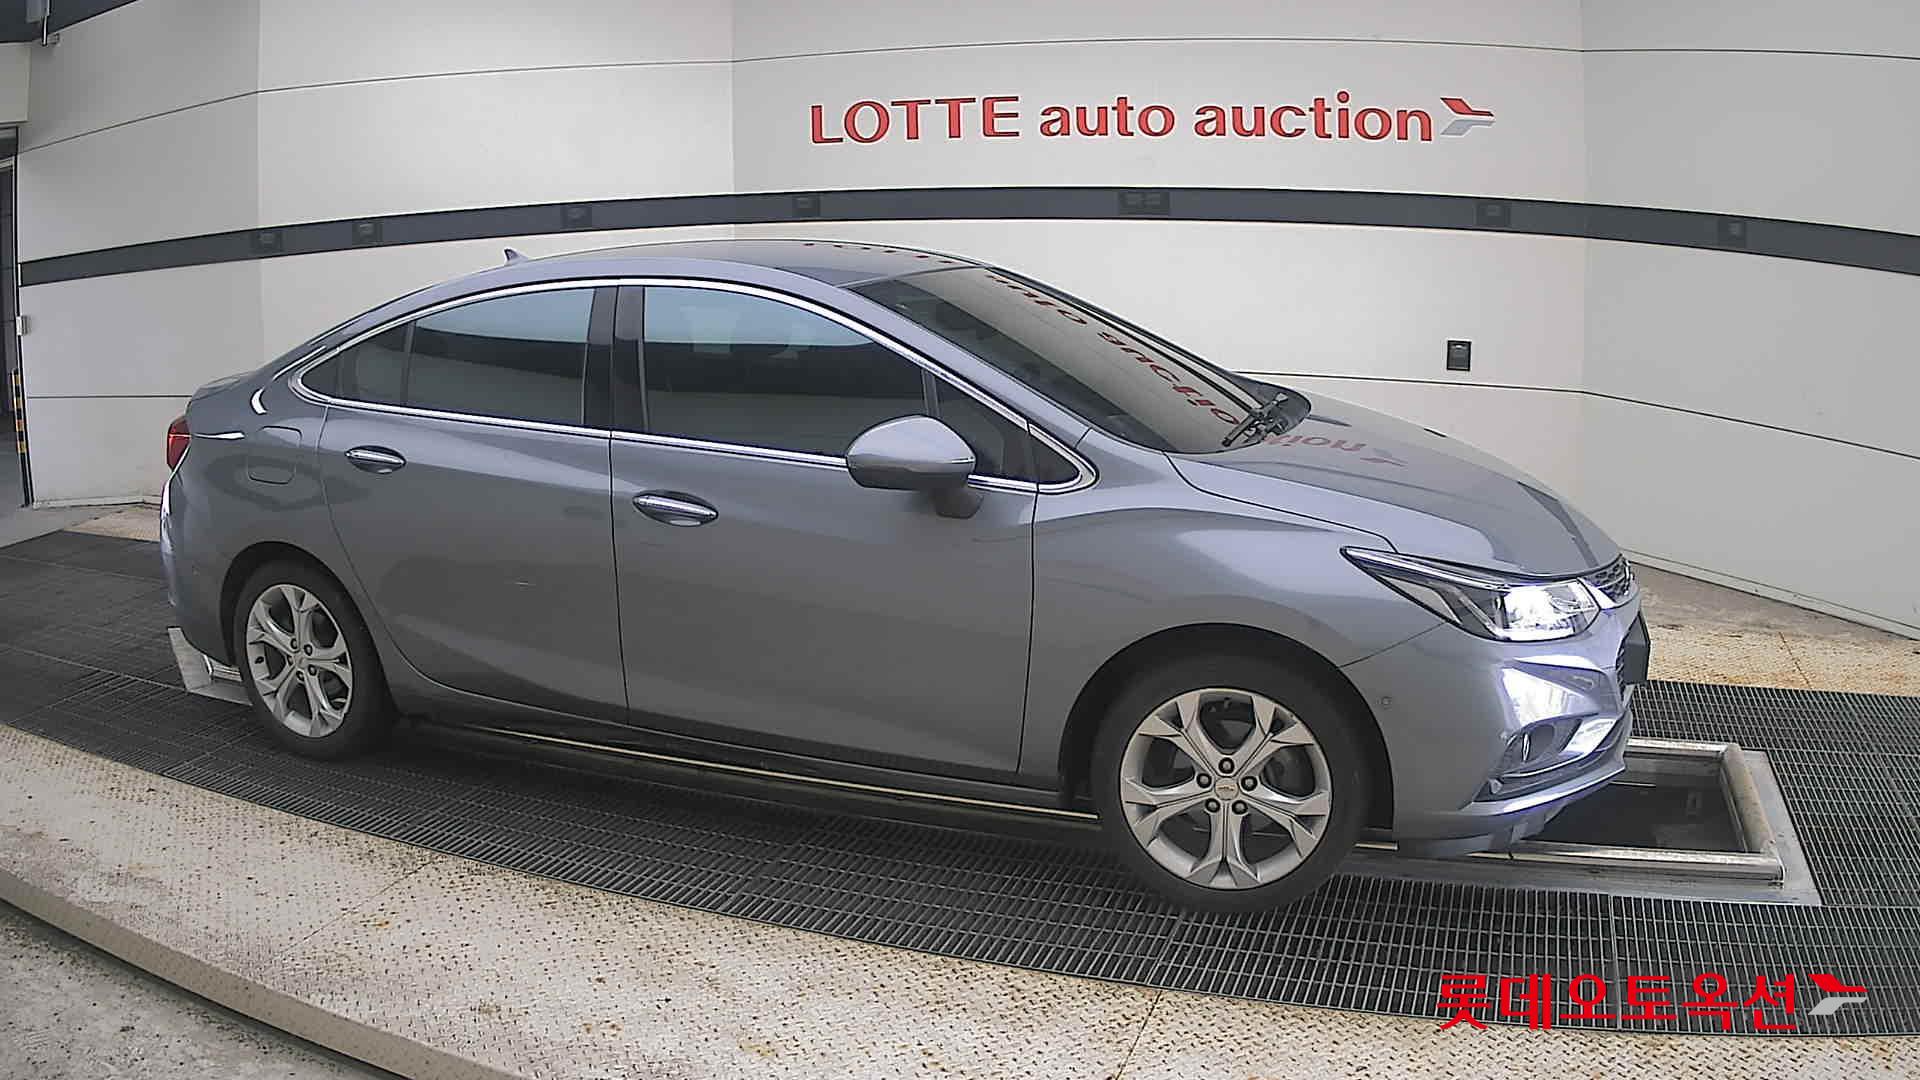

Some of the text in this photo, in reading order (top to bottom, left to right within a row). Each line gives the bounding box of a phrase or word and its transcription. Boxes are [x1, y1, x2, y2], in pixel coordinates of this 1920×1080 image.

[810, 90, 1434, 144] LOTTE auto auction
